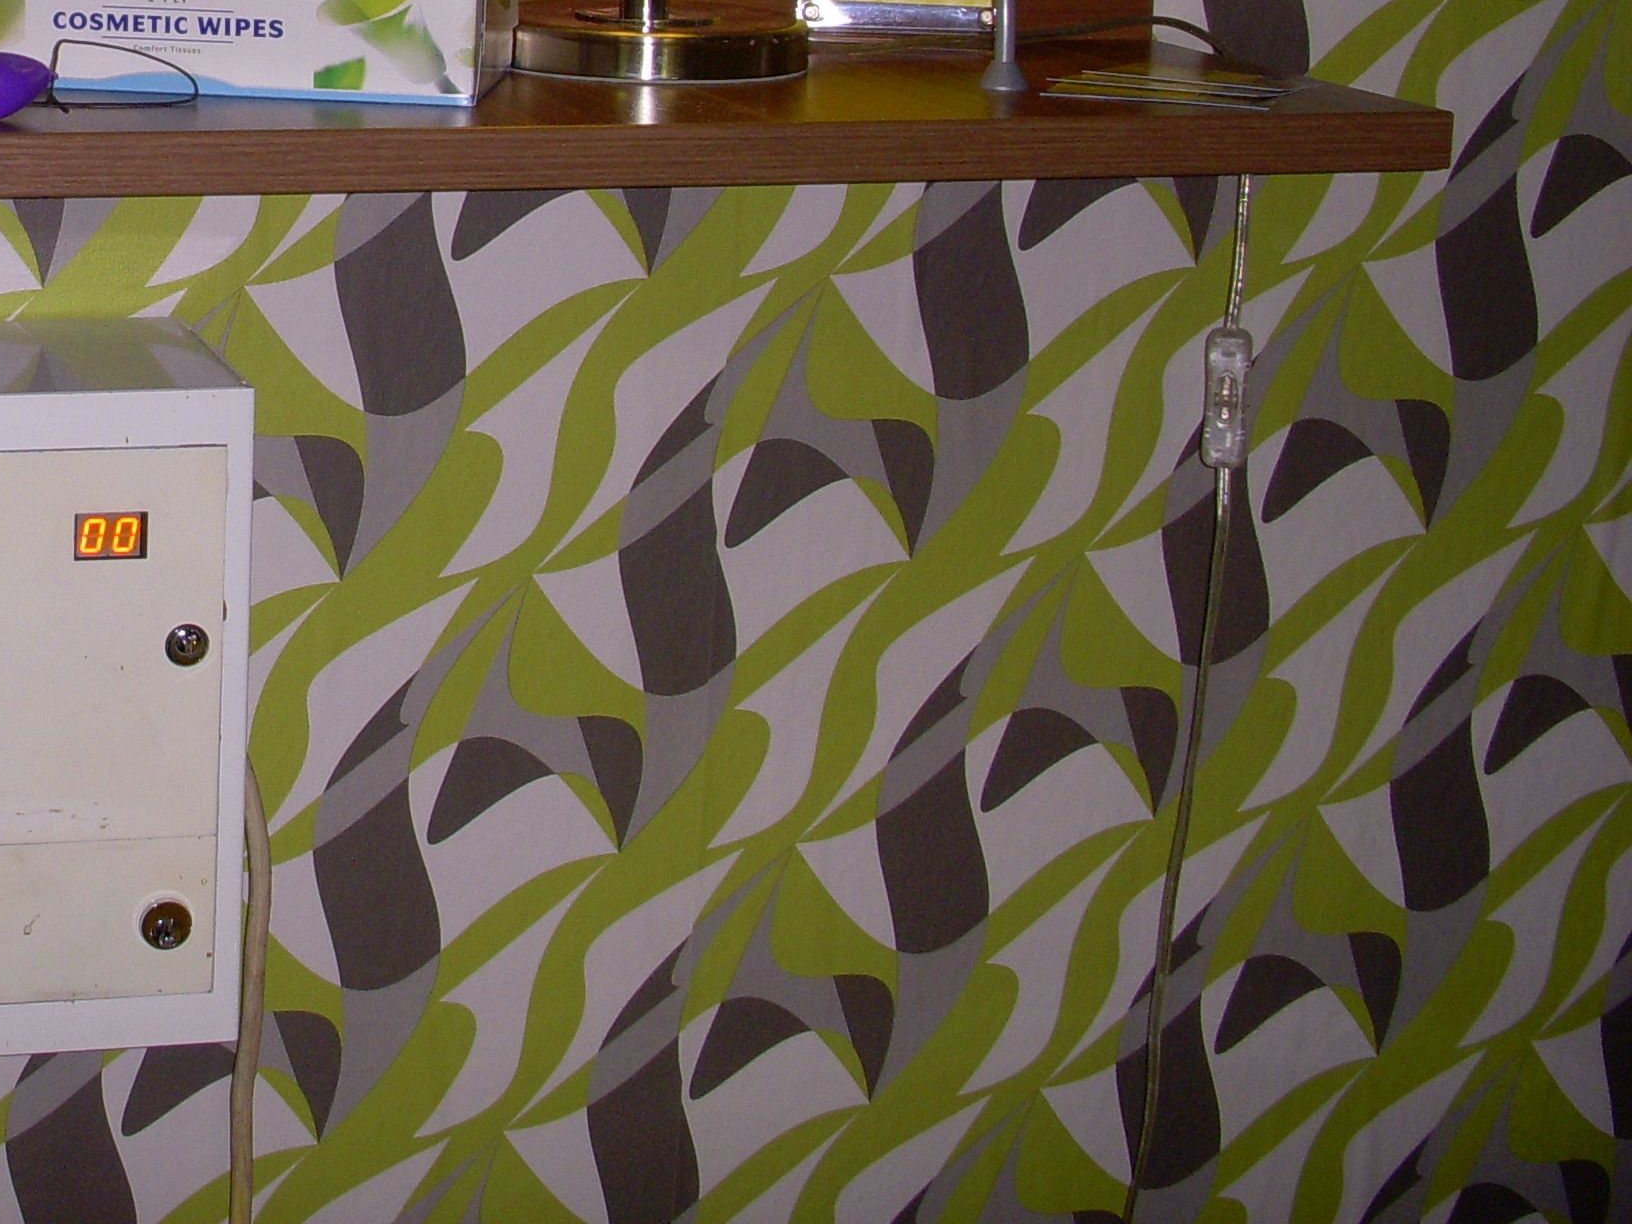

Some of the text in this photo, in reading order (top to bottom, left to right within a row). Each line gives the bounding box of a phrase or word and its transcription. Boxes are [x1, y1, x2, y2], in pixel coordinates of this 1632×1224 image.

[53, 11, 284, 38] COSMETIC WIPES
[133, 45, 201, 55] Comfort Tissues
[79, 517, 138, 553] 00
